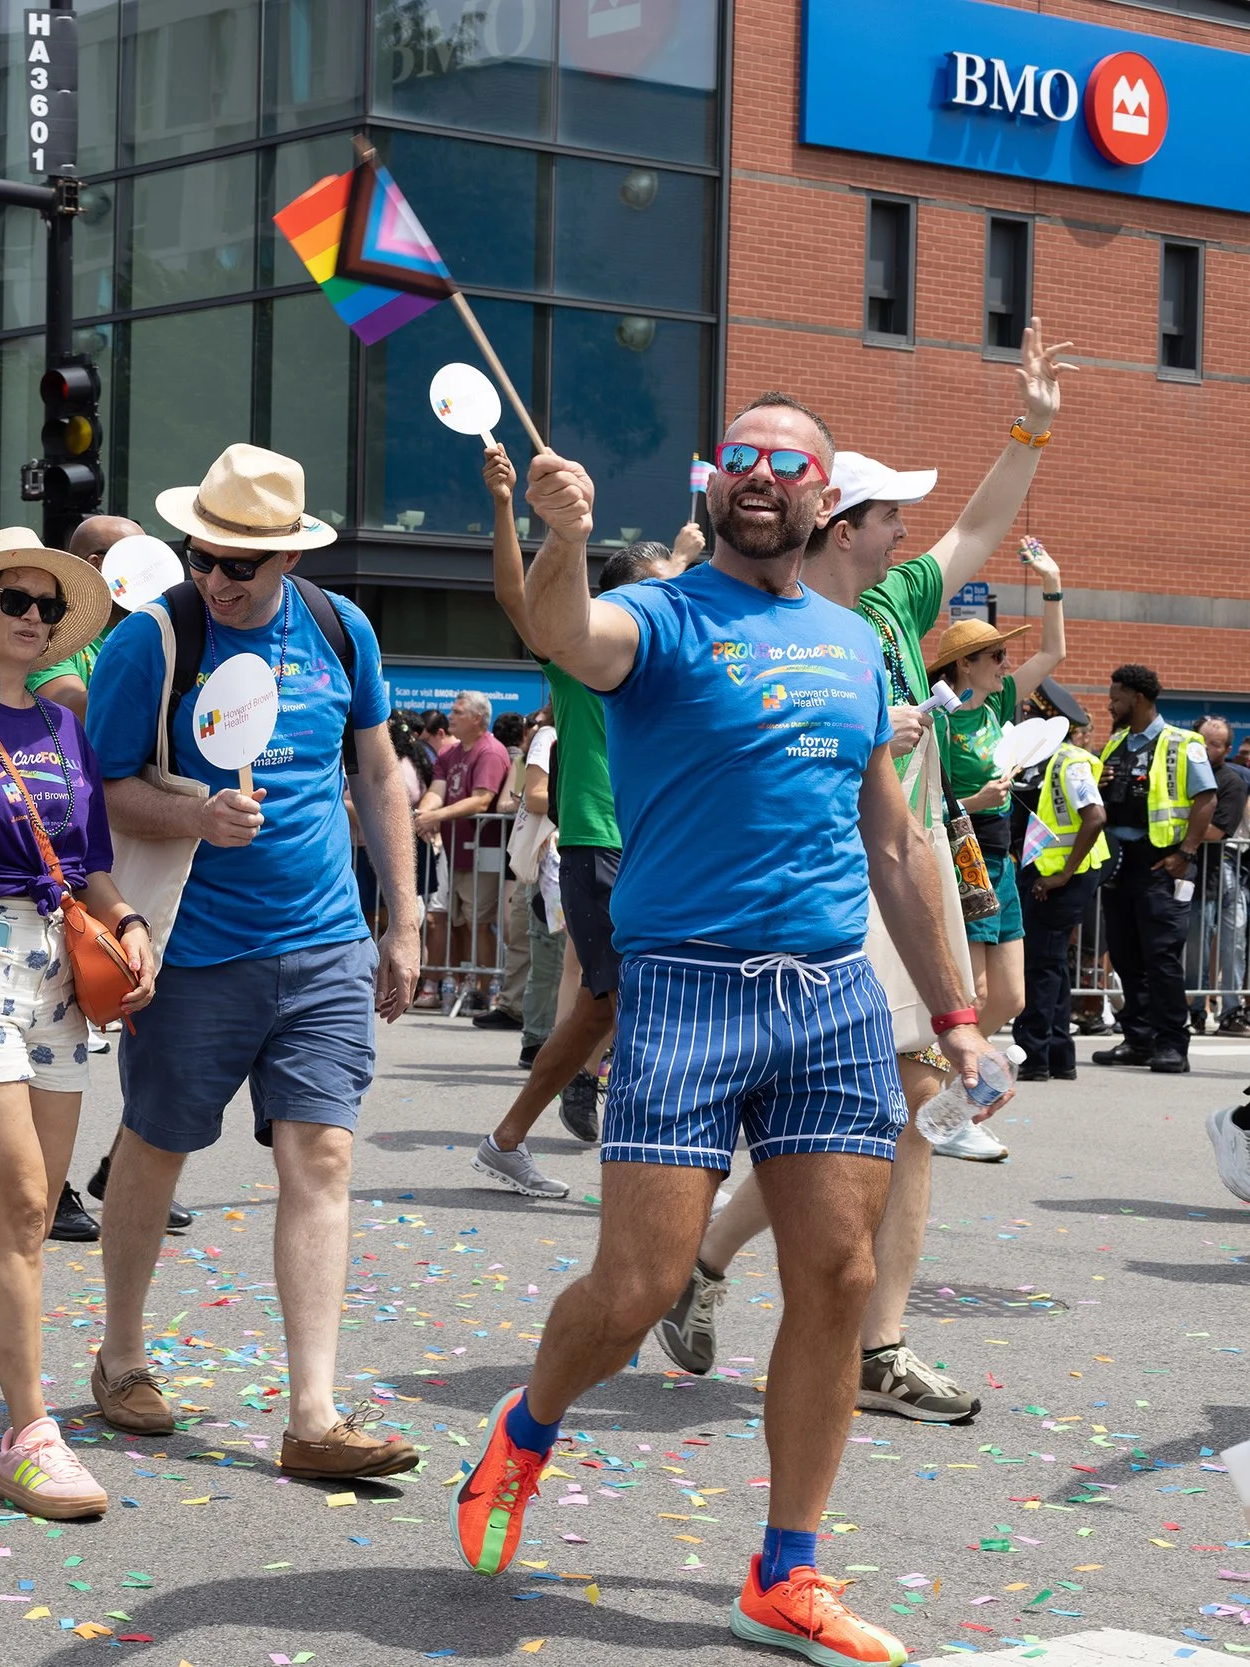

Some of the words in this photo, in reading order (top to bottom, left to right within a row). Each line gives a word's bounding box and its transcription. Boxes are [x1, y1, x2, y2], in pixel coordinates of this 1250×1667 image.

[952, 51, 1079, 122] BMO
[712, 641, 770, 662] PROUD
[769, 645, 786, 661] to
[786, 643, 823, 661] Care
[820, 643, 848, 661] FOR
[303, 657, 328, 675] ALL
[395, 687, 411, 697] Scan
[411, 689, 419, 697] or
[420, 688, 433, 698] visit
[790, 688, 829, 700] Howard
[831, 688, 858, 700] Brown
[223, 699, 253, 721] Howard
[253, 690, 274, 708] Brown
[282, 702, 307, 713] Brown
[395, 700, 403, 708] to
[403, 700, 425, 710] upload
[426, 702, 438, 710] any
[793, 697, 826, 708] Health
[224, 712, 250, 731] Health
[798, 733, 839, 748] forvis
[12, 750, 43, 767] Care
[785, 746, 838, 759] mazars
[253, 754, 294, 767] mazars
[1167, 749, 1177, 798] POLICE
[45, 791, 70, 801] Brown
[1051, 763, 1068, 815] POLICE
